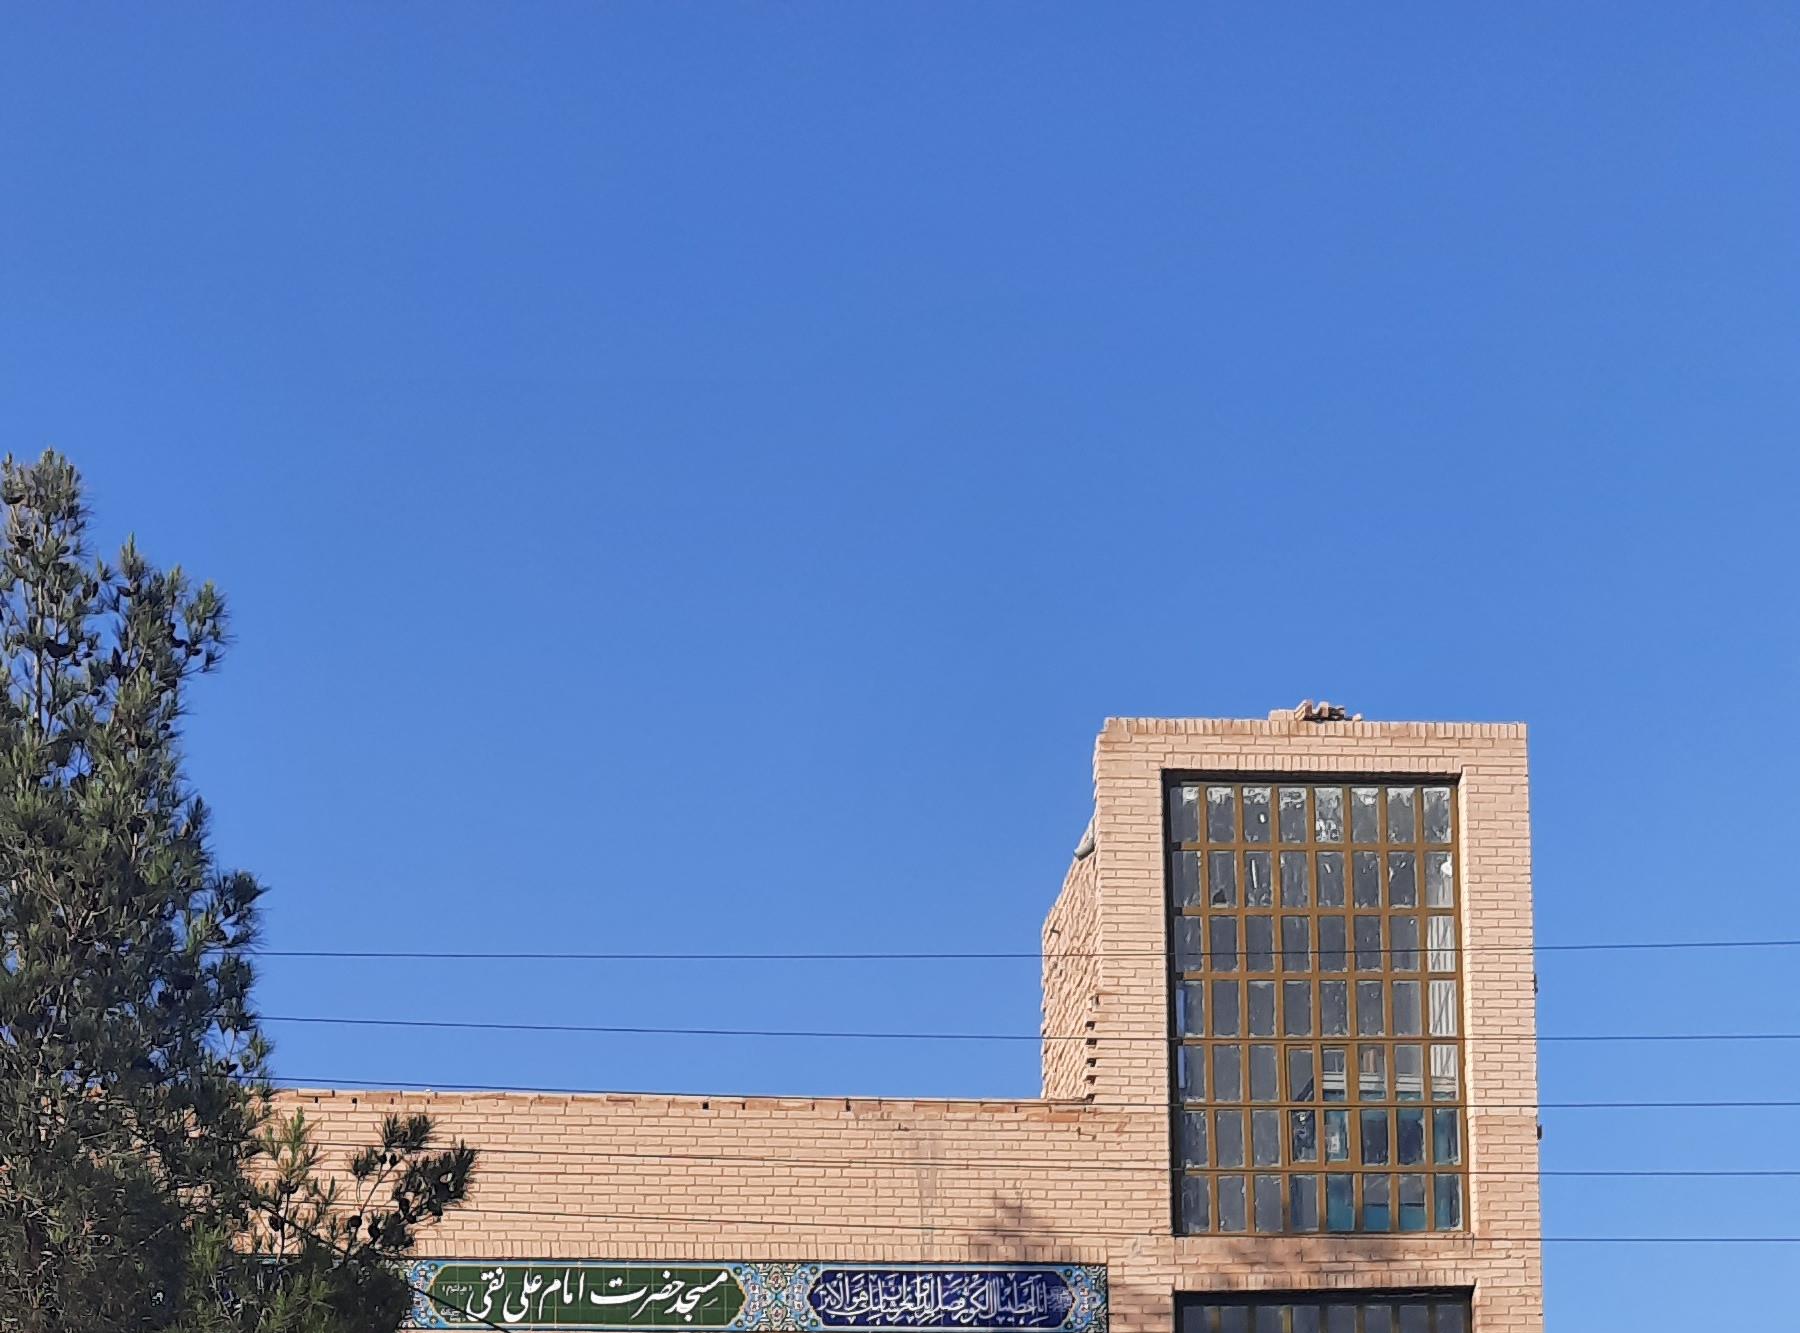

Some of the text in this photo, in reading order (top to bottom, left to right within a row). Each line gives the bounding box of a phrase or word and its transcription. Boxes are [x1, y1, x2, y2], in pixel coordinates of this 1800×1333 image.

[465, 1266, 505, 1322] نقی
[502, 1269, 544, 1322] علی
[538, 1268, 587, 1320] امام
[590, 1270, 683, 1320] حضرت
[664, 1270, 728, 1321] مسجد
